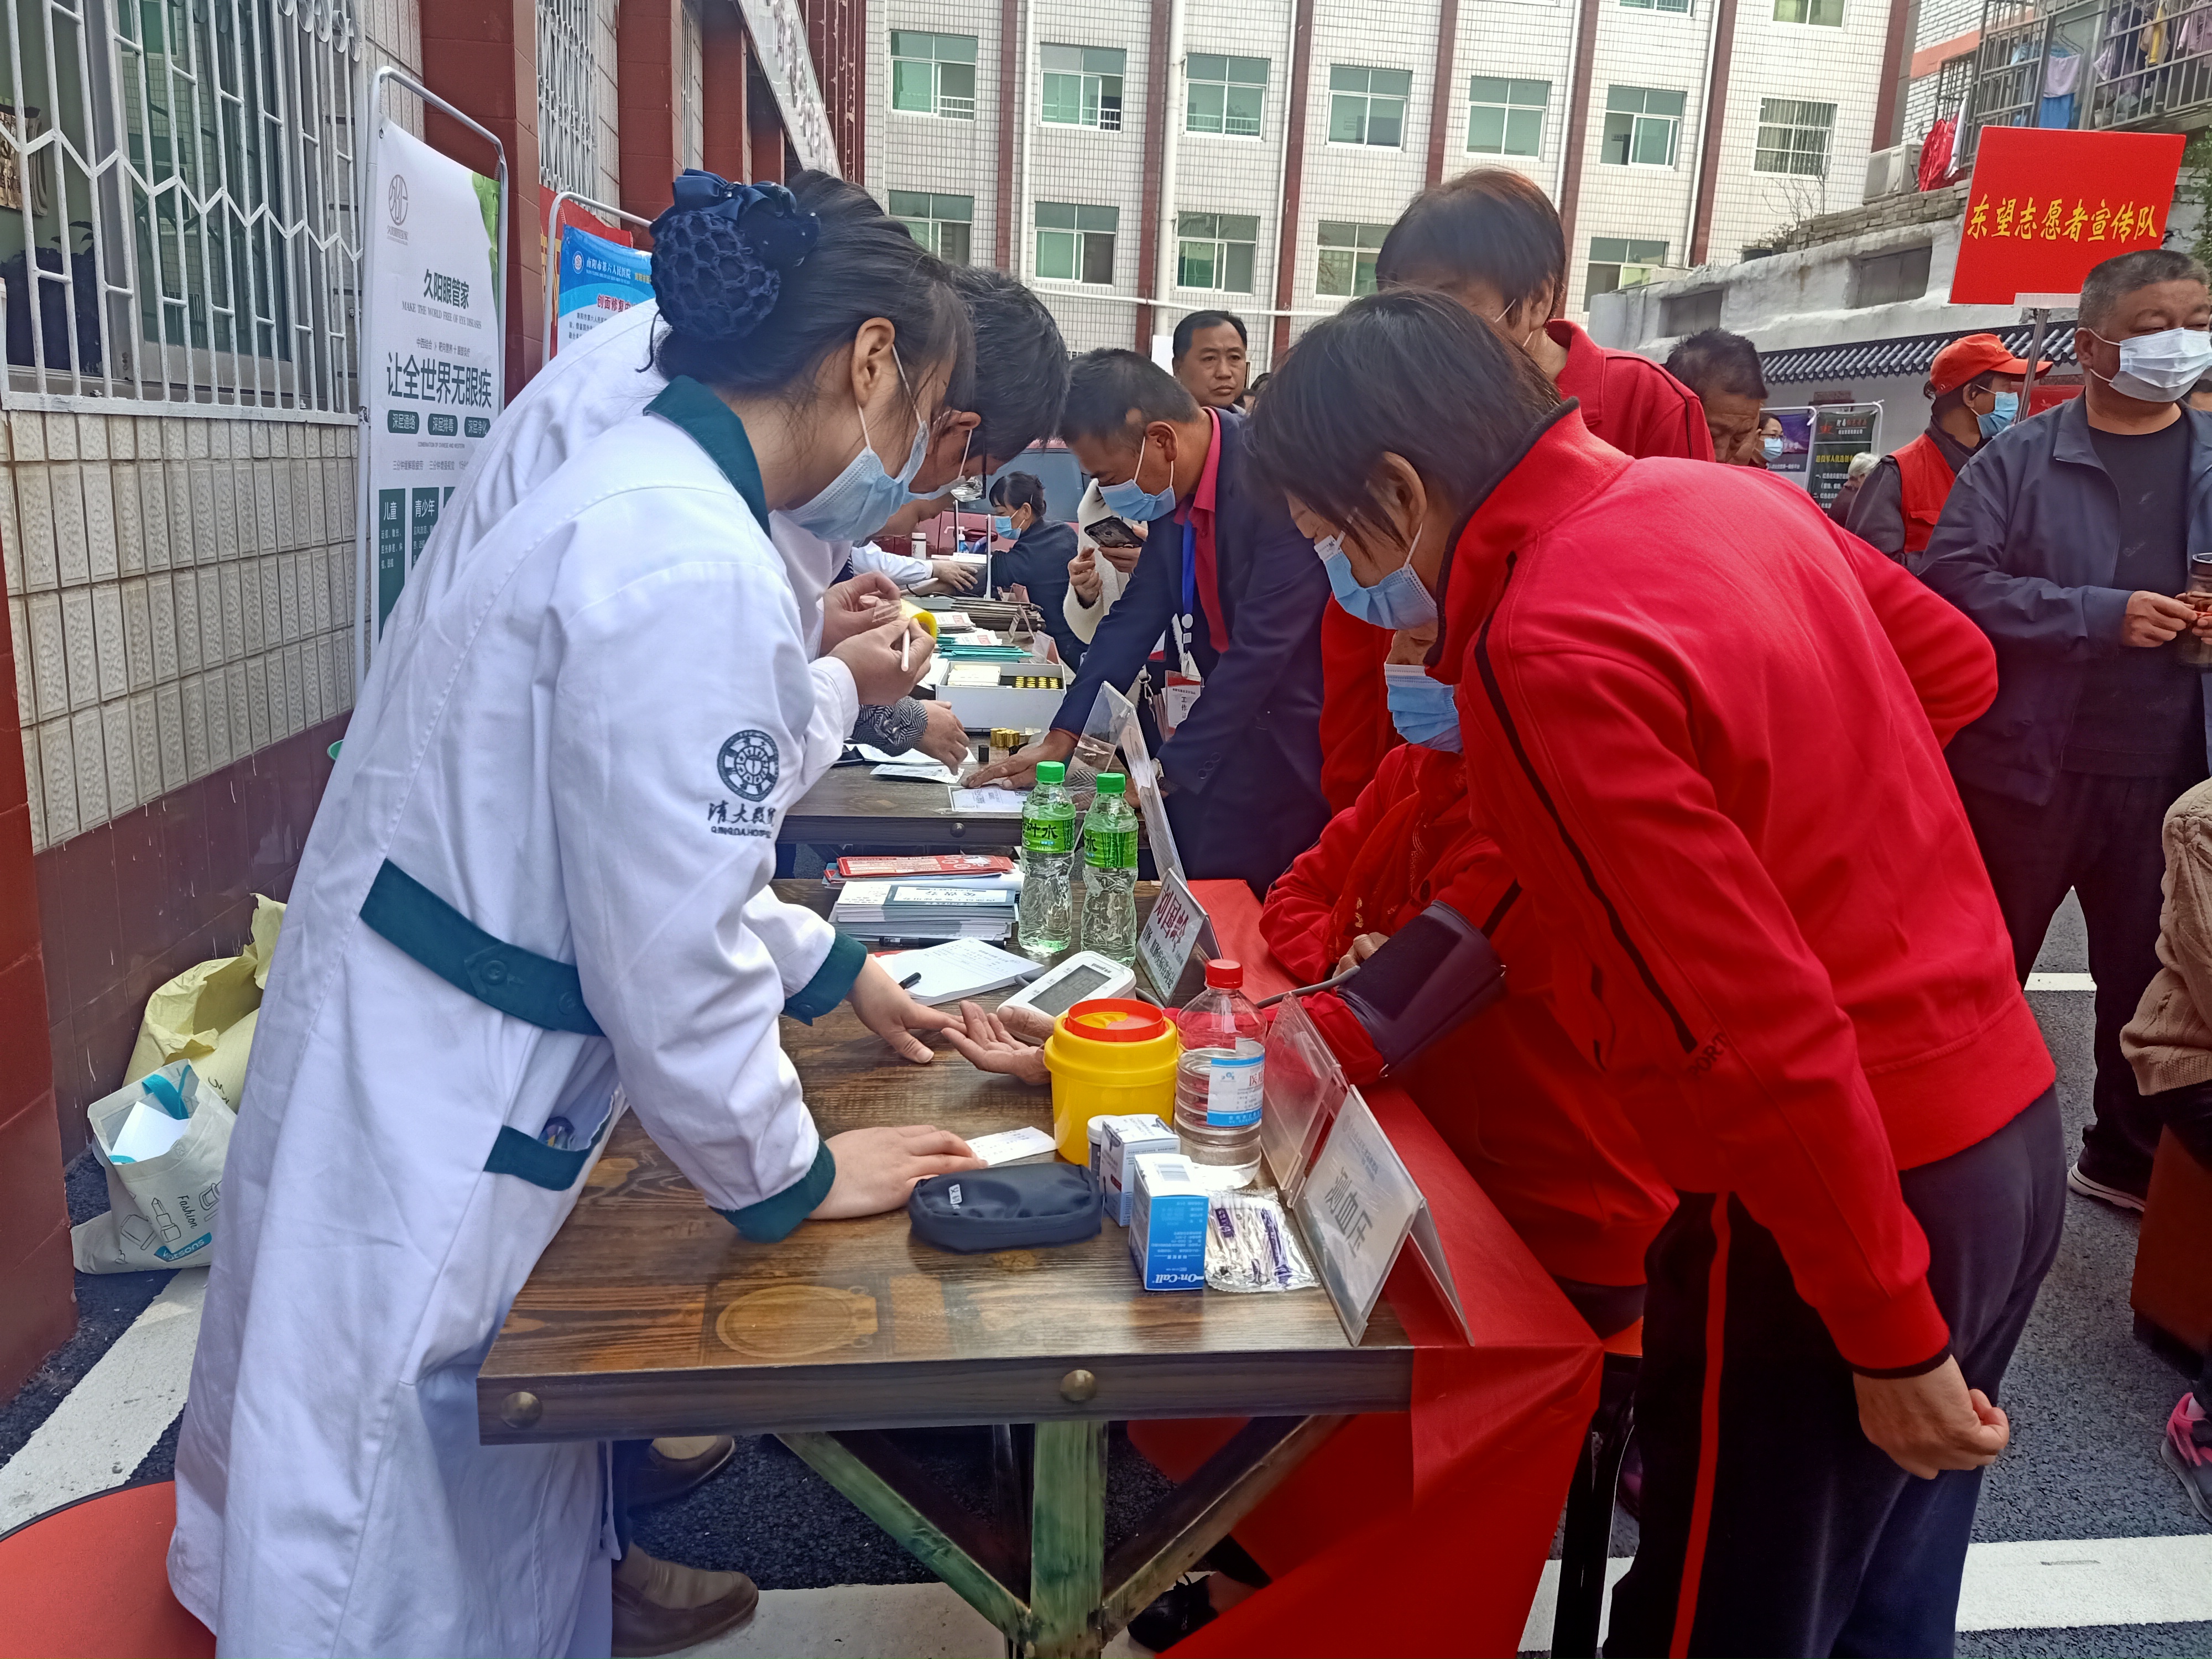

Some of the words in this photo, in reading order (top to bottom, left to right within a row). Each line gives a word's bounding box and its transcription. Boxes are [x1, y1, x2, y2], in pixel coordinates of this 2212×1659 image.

[1966, 193, 2157, 243] 东望志愿者宣传队
[586, 257, 631, 279] 南阳市第六人民医院
[423, 268, 469, 310] 久阳眼管家
[597, 294, 632, 313] 创面修复中
[402, 300, 416, 313] MAKE
[418, 305, 426, 315] THE
[428, 306, 442, 319] WORLD
[443, 311, 452, 322] FREE
[453, 315, 458, 323] OF
[466, 317, 482, 330] DISEASES
[387, 352, 492, 409] 让全世界无眼疾
[432, 416, 454, 434] 深层排毒
[383, 500, 397, 520] 儿童
[415, 498, 435, 518] 青少年
[178, 1194, 197, 1229] Fashion
[1324, 1166, 1374, 1259] 测血压
